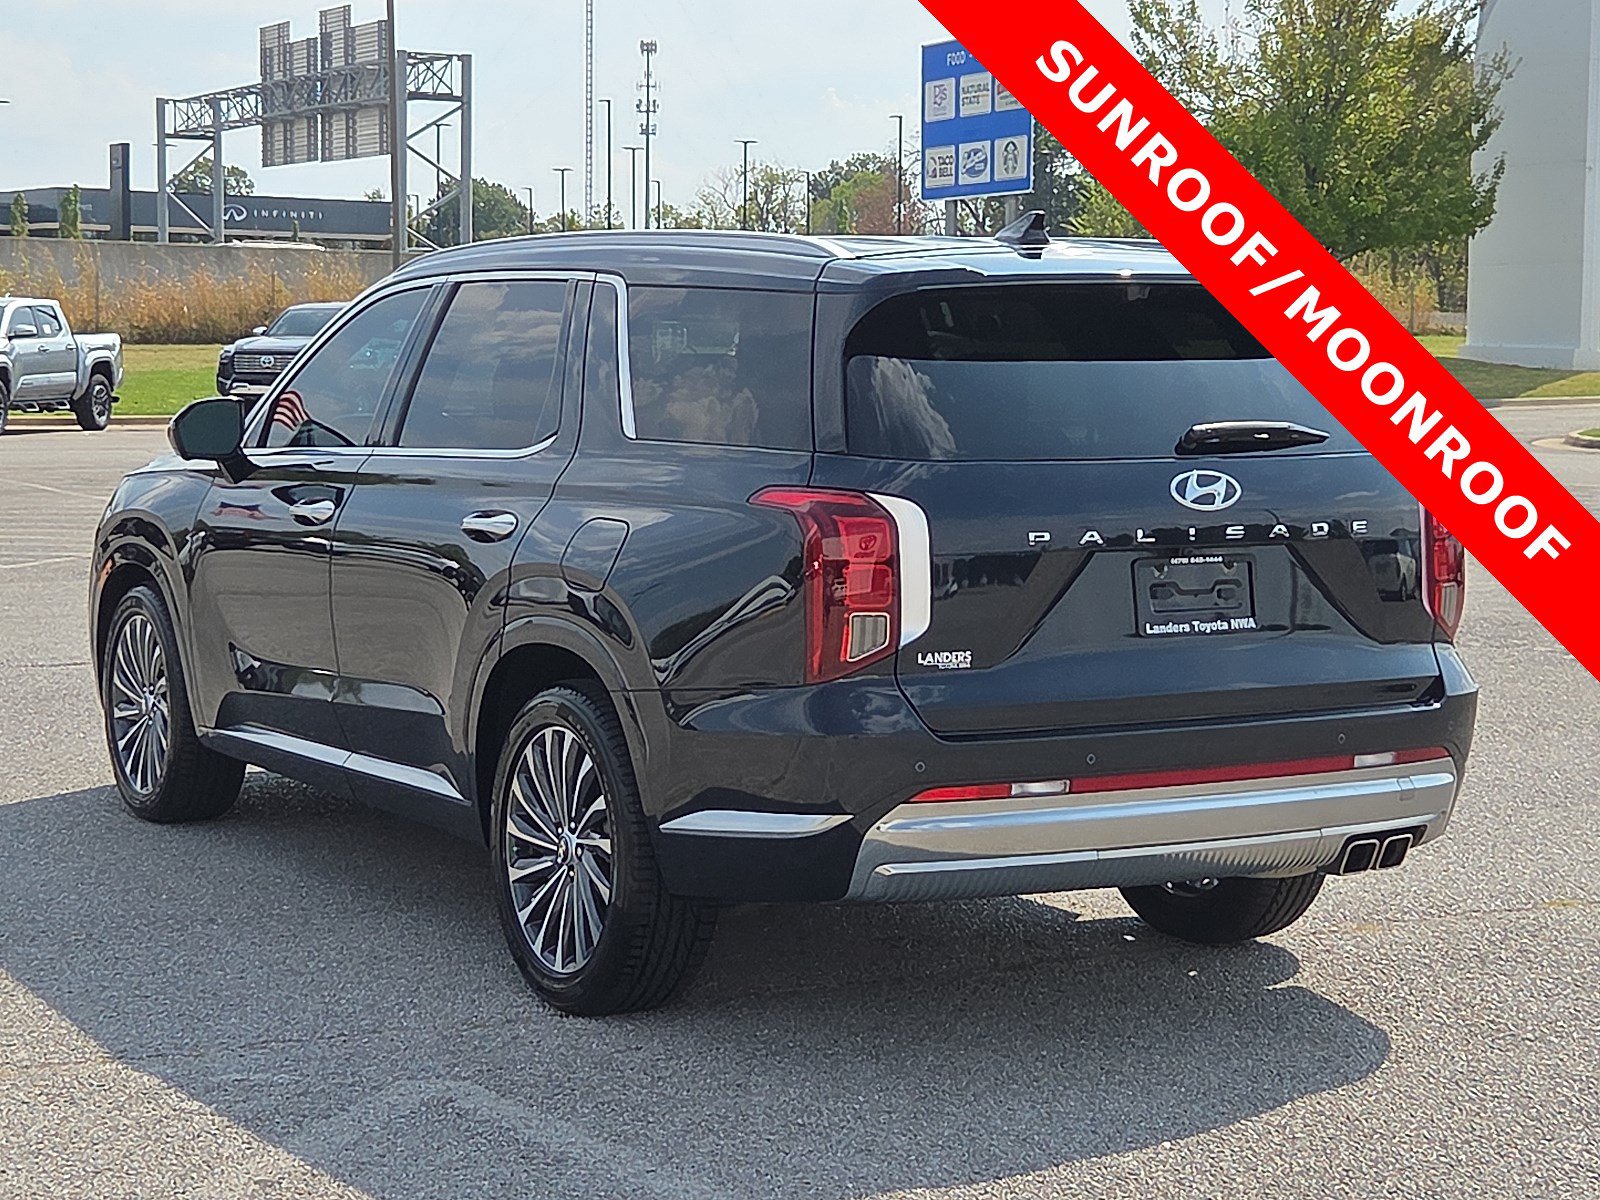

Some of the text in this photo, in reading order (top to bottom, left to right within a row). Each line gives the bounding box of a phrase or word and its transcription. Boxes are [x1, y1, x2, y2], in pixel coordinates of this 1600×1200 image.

[946, 50, 967, 66] FOOD
[961, 82, 990, 95] NATURAL
[961, 95, 981, 107] STATE
[937, 155, 954, 166] TACO
[938, 166, 954, 178] BELL
[253, 208, 324, 220] INFINITI
[1028, 520, 1368, 546] PALISADE
[1145, 617, 1257, 634] Landers Toyota NWA
[917, 650, 972, 665] LANDERS
